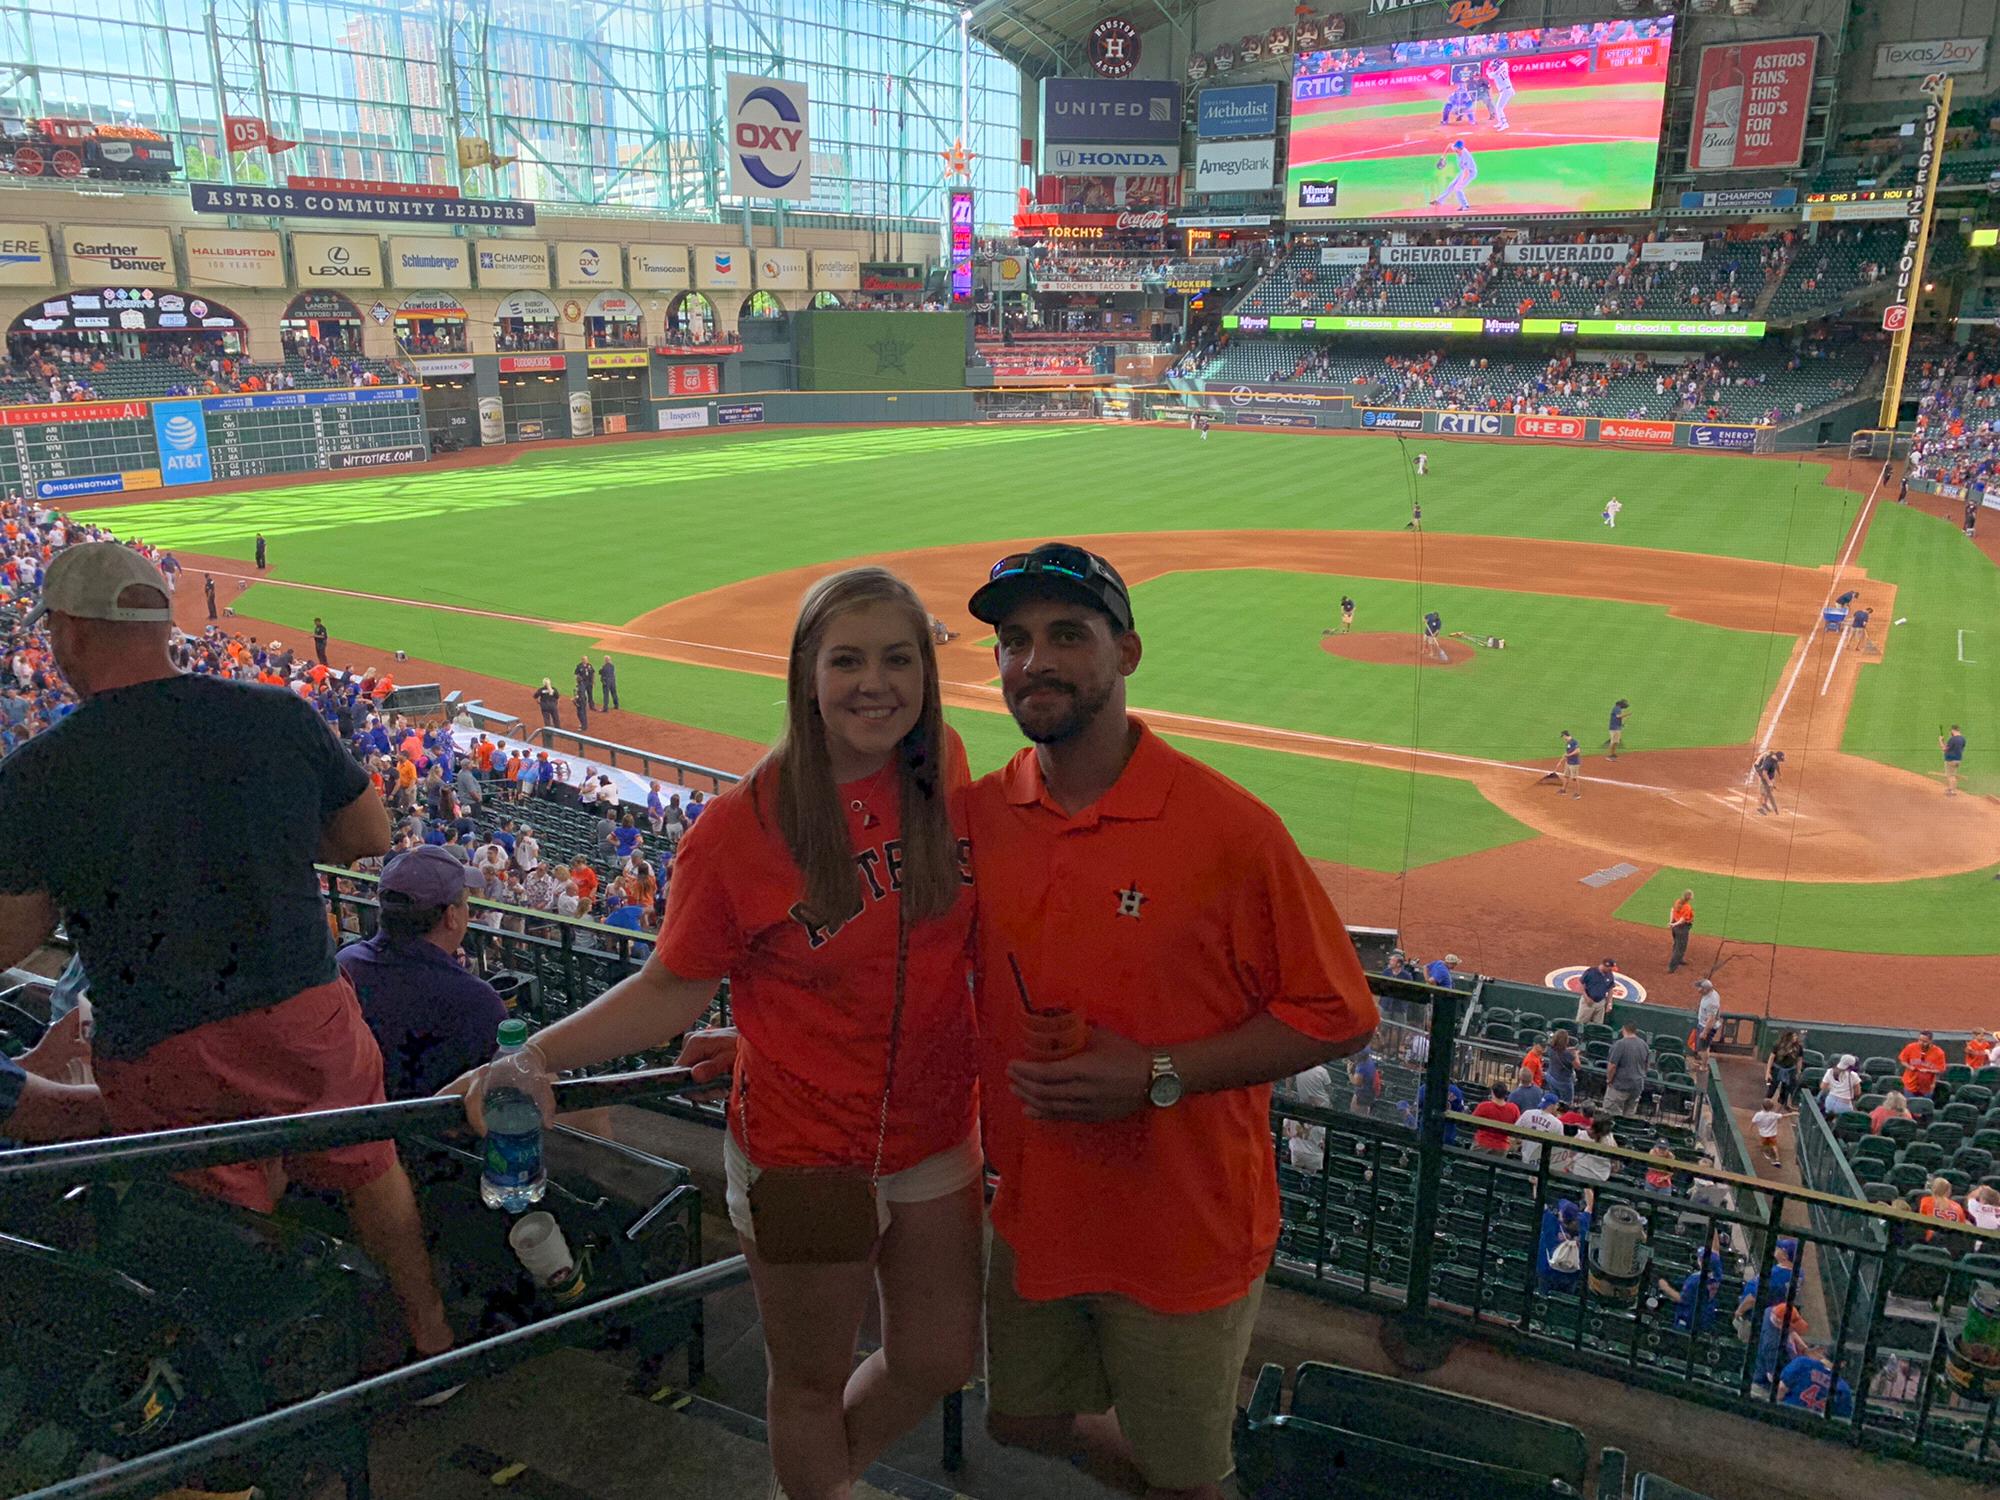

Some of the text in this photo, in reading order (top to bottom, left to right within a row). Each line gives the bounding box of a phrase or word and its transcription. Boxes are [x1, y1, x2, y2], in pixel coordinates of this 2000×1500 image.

[1095, 21, 1135, 37] HOUSTON
[1105, 38, 1124, 57] H
[1096, 60, 1132, 74] ASTROS
[1527, 60, 1567, 70] AMERICA
[1754, 52, 1806, 69] ASTROS
[1354, 80, 1376, 88] BANK
[1390, 74, 1427, 84] AMERICA
[1752, 70, 1789, 84] FANS,
[1297, 76, 1344, 97] RTIC
[1751, 86, 1780, 100] THIS
[1055, 101, 1143, 116] UNITED
[1204, 102, 1268, 119] Methodist
[1748, 101, 1788, 116] BUD'S
[234, 122, 258, 142] 05
[1746, 118, 1771, 132] FOR
[736, 122, 803, 152] OXY
[1744, 133, 1773, 147] YOU.
[1078, 153, 1167, 166] HONDA
[1199, 156, 1270, 175] AmegyBank
[1302, 184, 1334, 195] Minute
[1718, 192, 1772, 201] CHAMPION
[1883, 190, 1902, 199] HOU
[207, 191, 524, 220] ASTROS COMMUNITY LEADERS
[1306, 194, 1330, 204] Maid
[73, 242, 138, 256] Gardner
[192, 247, 276, 257] HALLIBURTON
[1390, 248, 1482, 263] CHEVROLET
[1519, 245, 1614, 261] SILVERADO
[110, 257, 166, 271] Denver
[402, 254, 459, 270] Schlumberger
[494, 253, 545, 264] CHAMPION
[579, 258, 599, 266] OXY
[309, 266, 371, 276] LEXUS
[643, 264, 685, 273] Transocean
[1101, 282, 1126, 290] TACOS
[404, 301, 438, 310] Crawford
[1485, 319, 1520, 330] Minute
[669, 411, 701, 421] Insperity
[1376, 412, 1395, 420] AT&T
[1438, 413, 1499, 433] RTIC
[1376, 419, 1421, 428] SPORTSNET
[1719, 431, 1755, 440] ENERGY
[168, 453, 203, 470] AT&T
[343, 449, 413, 467] NITTOTIRE.COM
[52, 480, 119, 492] HIGGINBOTHAM
